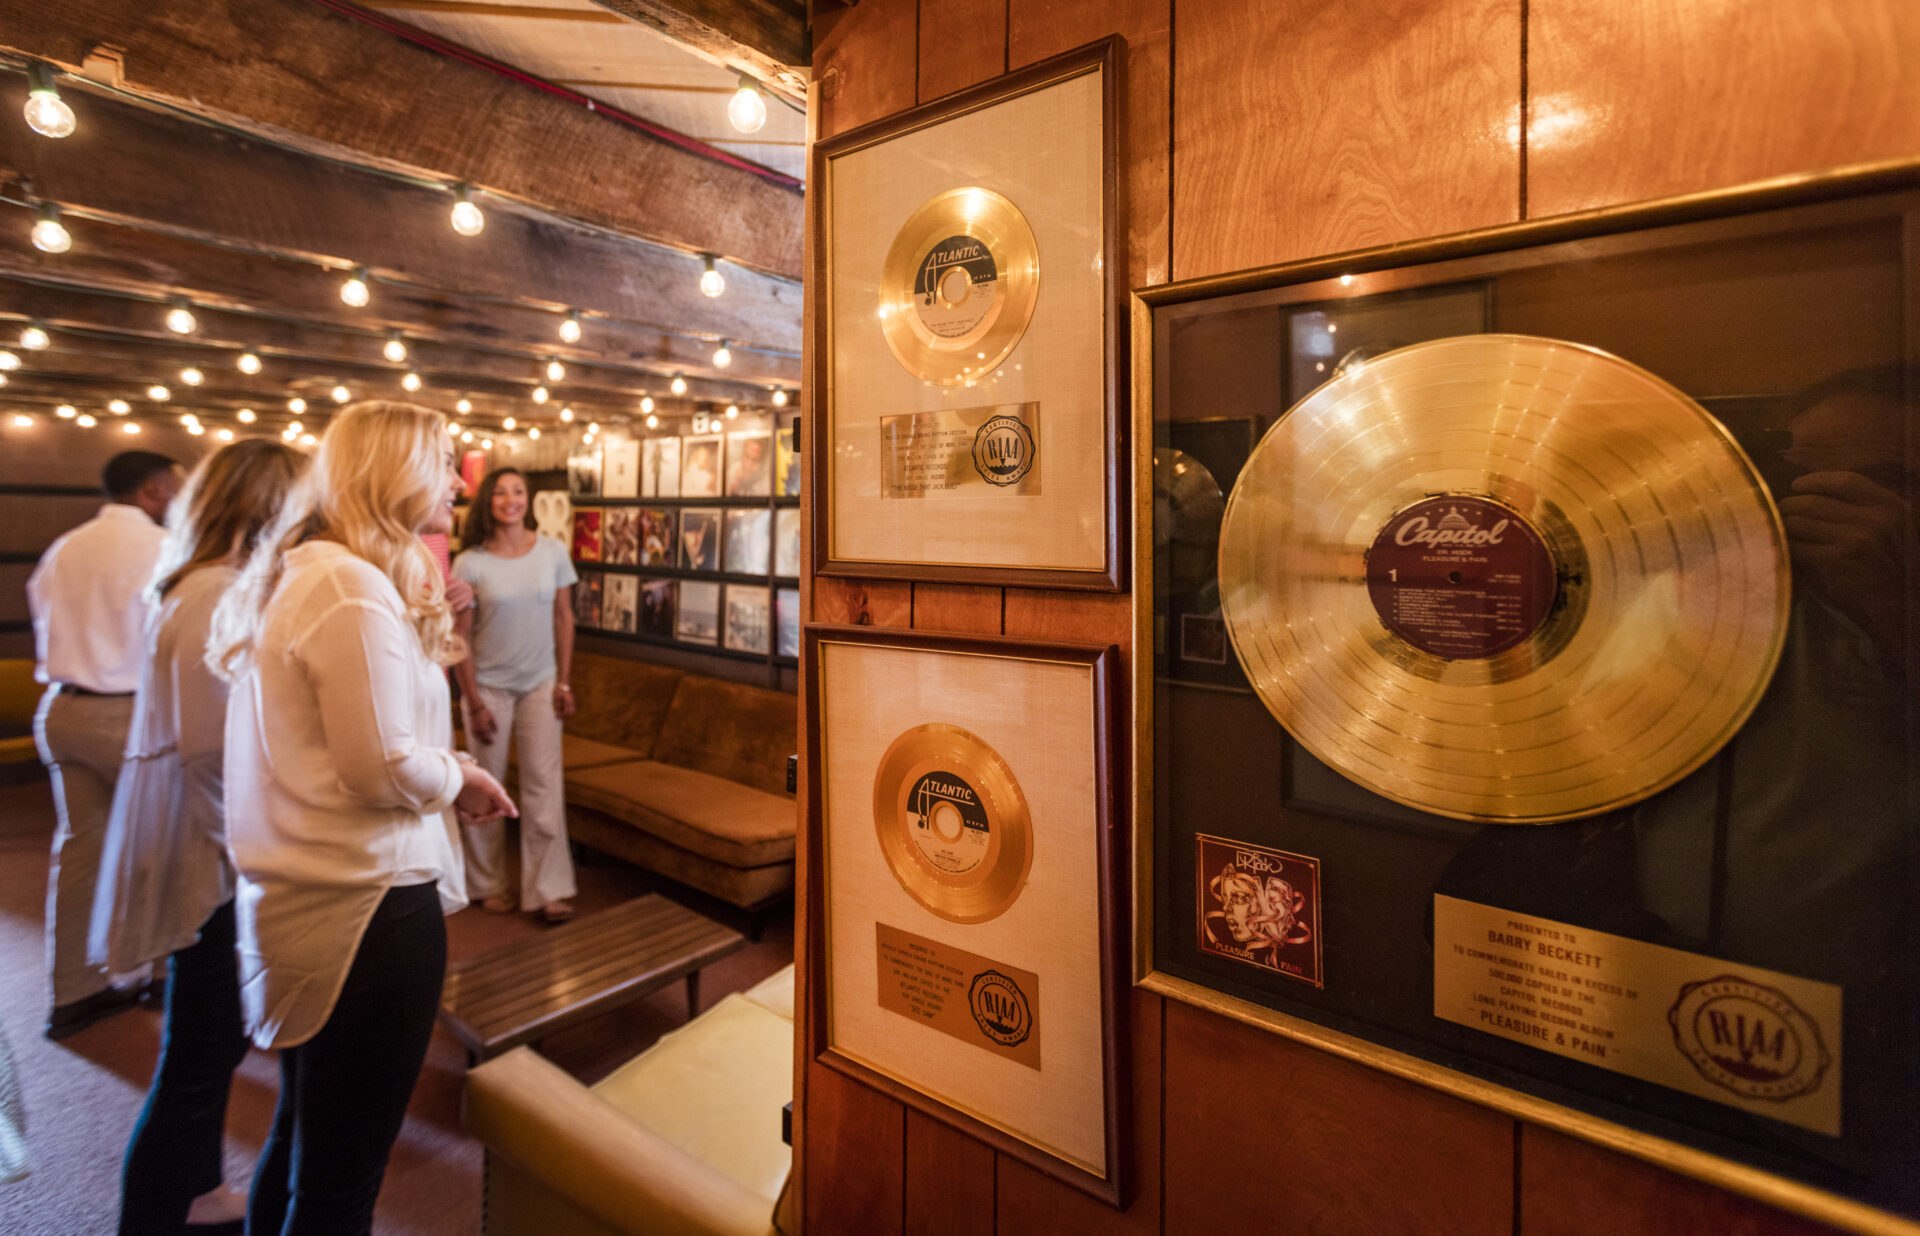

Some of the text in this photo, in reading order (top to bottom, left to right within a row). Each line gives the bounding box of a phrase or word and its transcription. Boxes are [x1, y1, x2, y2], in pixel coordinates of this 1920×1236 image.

[986, 420, 1021, 434] CERTIFIED
[988, 437, 1018, 460] RIAA
[1395, 516, 1509, 549] Capitol
[1388, 568, 1397, 582] 1
[1507, 920, 1577, 944] PRESENTED TO
[1215, 942, 1255, 961] PLEASURE
[1487, 929, 1603, 969] BARRY BECKETT
[1453, 944, 1465, 955] TO
[1467, 948, 1536, 974] COMMEMORATE
[1538, 967, 1569, 983] SALES
[1571, 975, 1582, 985] IN
[1585, 979, 1623, 997] EXCESS
[984, 991, 1015, 1022] RIAA
[1500, 986, 1583, 1017] CAPITOL RECORDS
[1525, 978, 1560, 996] COPIES
[1577, 992, 1596, 1005] THE
[1473, 992, 1614, 1039] LONG PLAYING RECORD ALBUM
[1481, 1010, 1606, 1058] PLEASURE & PAIN
[1708, 1009, 1786, 1062] RIAA
